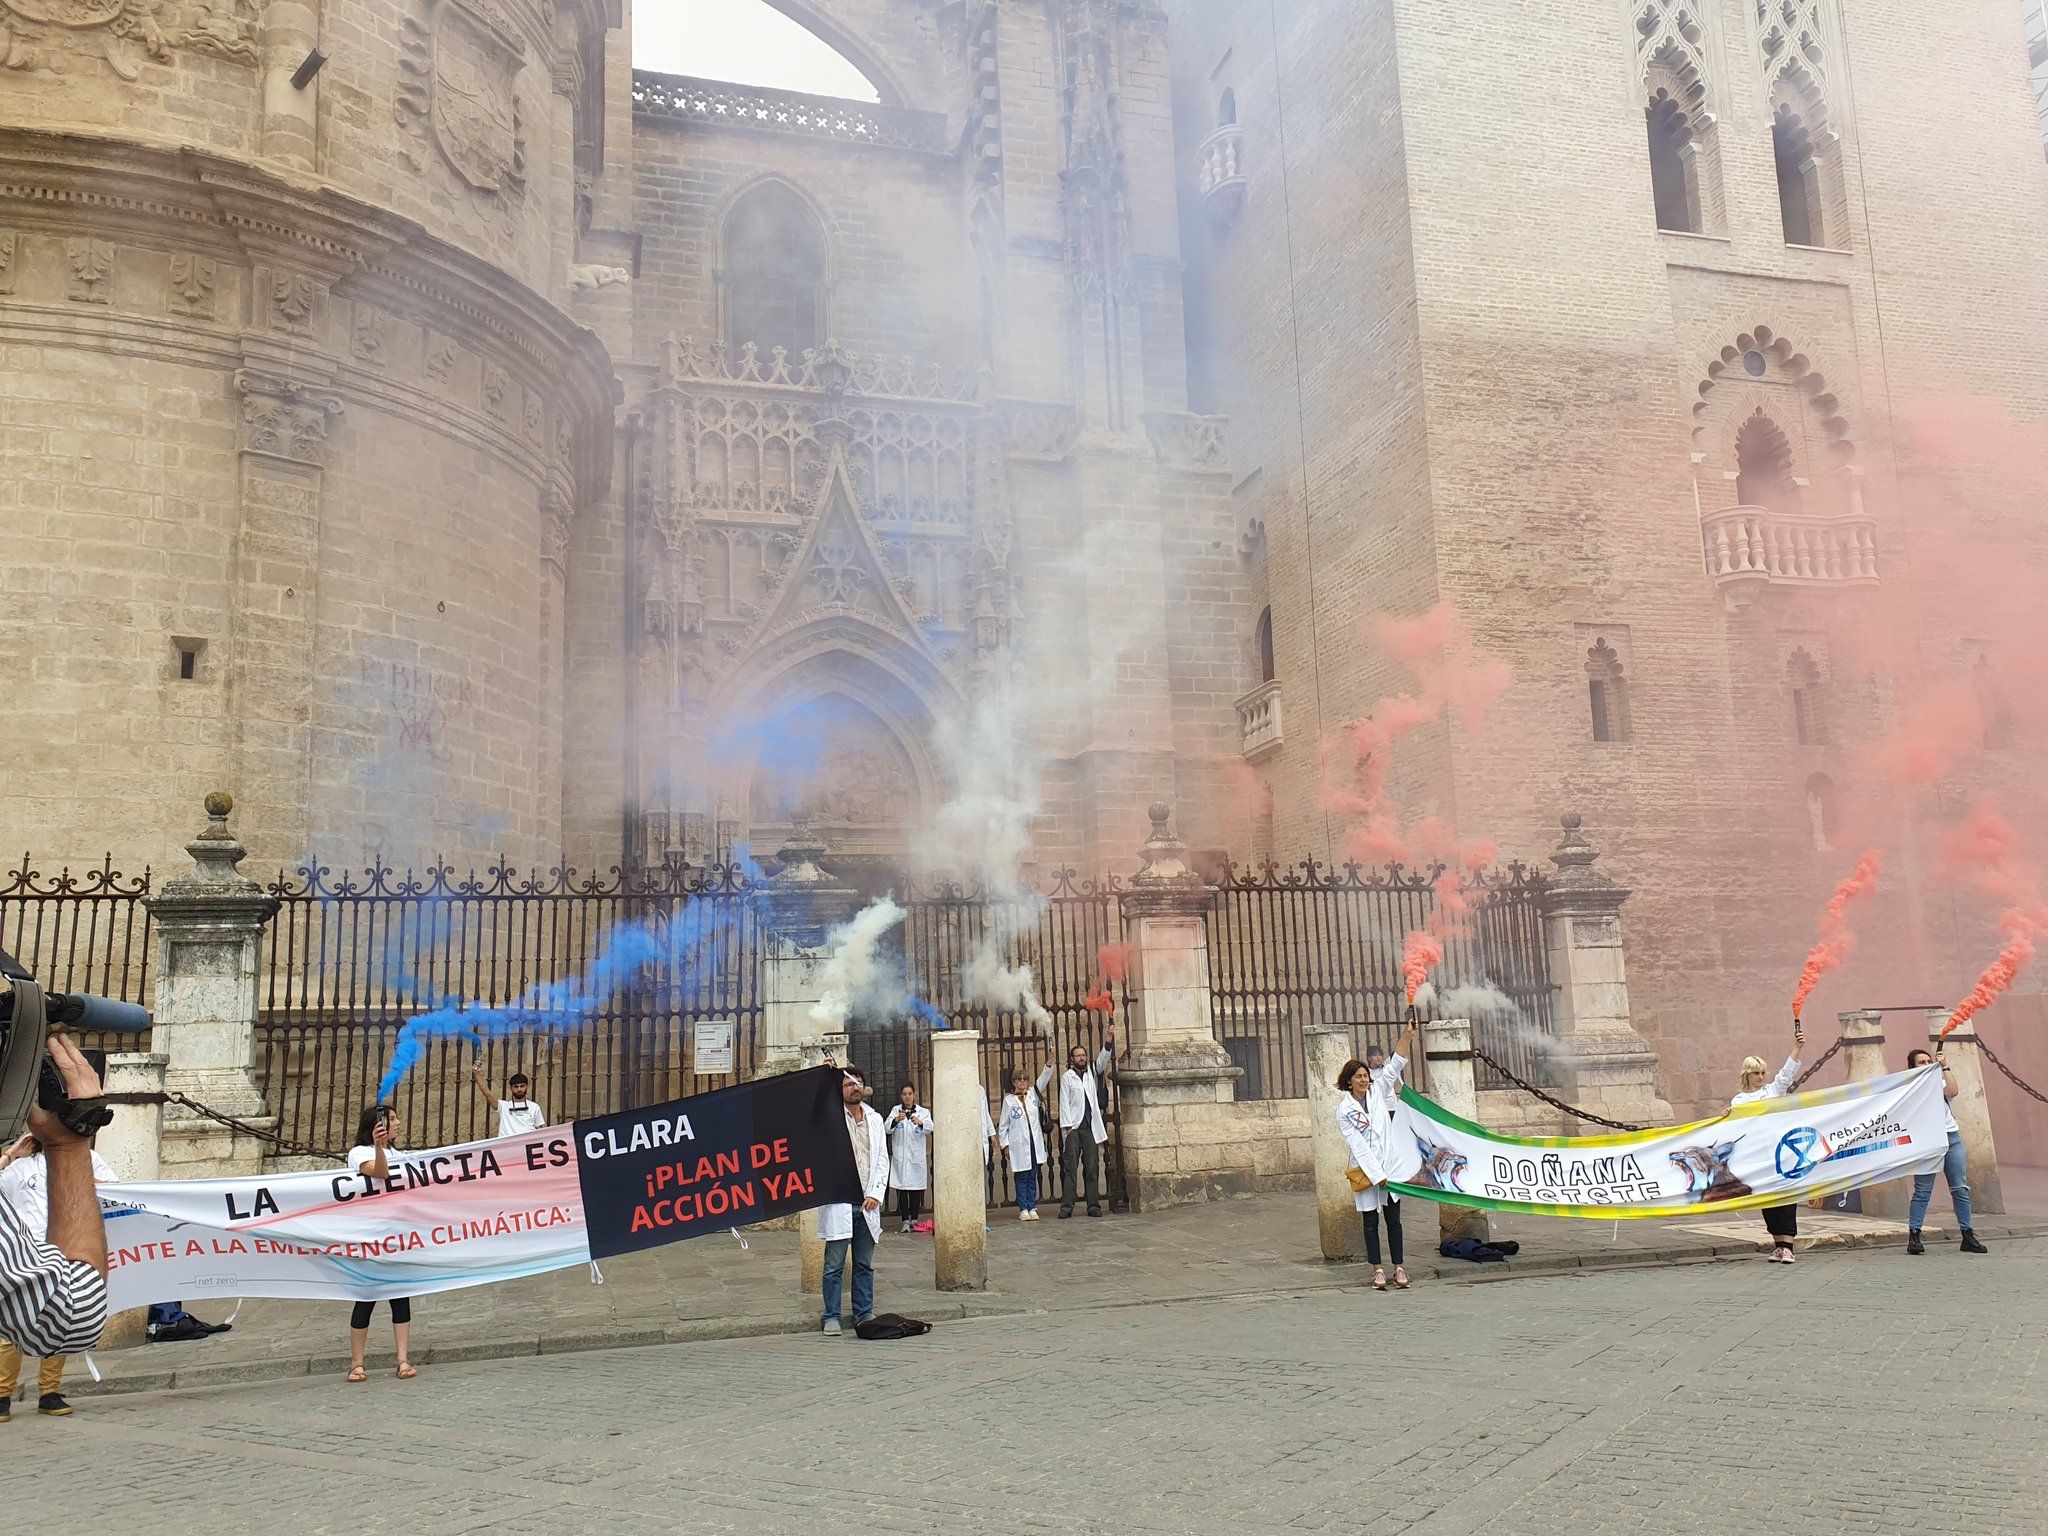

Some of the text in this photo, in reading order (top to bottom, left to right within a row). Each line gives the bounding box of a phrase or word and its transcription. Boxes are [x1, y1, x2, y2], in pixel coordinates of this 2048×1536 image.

[225, 1114, 696, 1221] LA CIENCIA ES CLARA
[645, 1137, 790, 1198] ¡PLAN DE
[1492, 1153, 1645, 1187] DOÑANA
[630, 1168, 815, 1233] ACCIÓN YA!
[105, 1241, 177, 1271] ENTE
[185, 1239, 206, 1257] A
[212, 1238, 248, 1255] LA
[431, 1206, 572, 1245] CLIMÁTICA:
[197, 1276, 236, 1286] net zero
